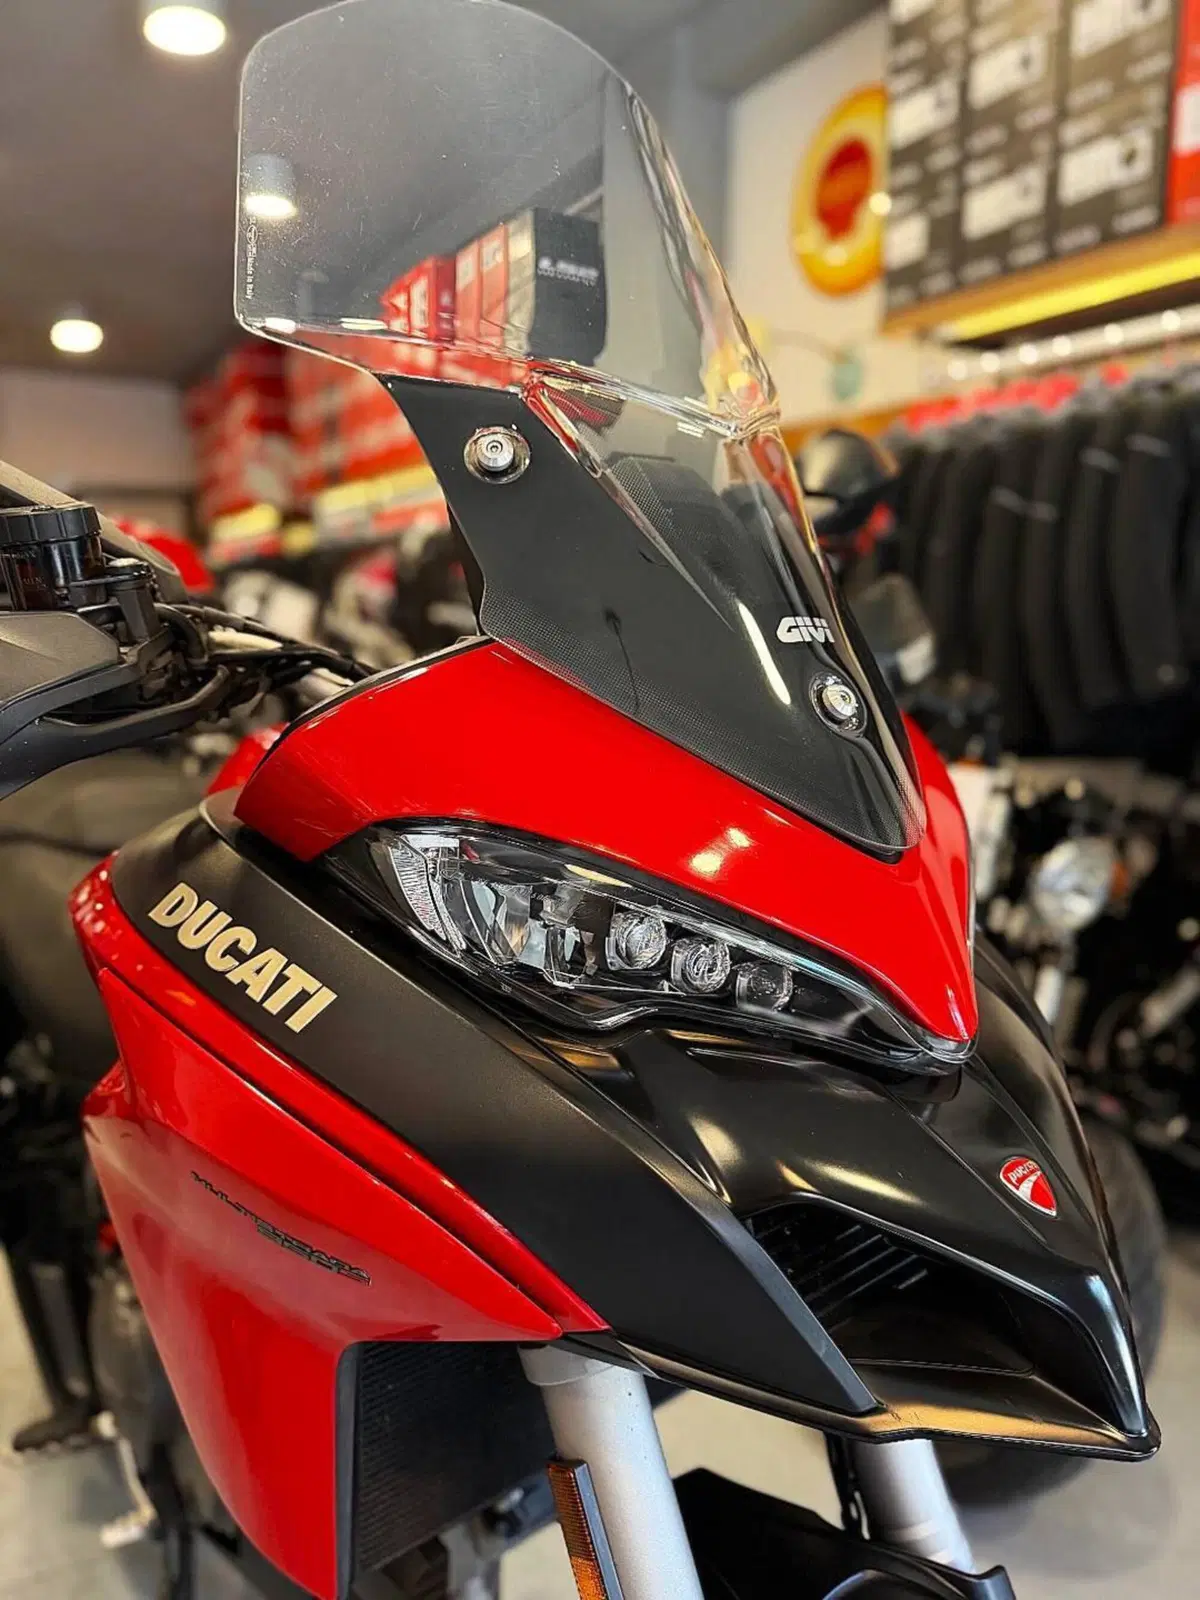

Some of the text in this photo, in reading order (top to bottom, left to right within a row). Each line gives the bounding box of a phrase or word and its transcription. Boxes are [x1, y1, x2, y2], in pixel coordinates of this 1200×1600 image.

[246, 258, 255, 274] Made
[245, 284, 254, 299] Italy
[776, 616, 835, 643] GIVI
[148, 882, 338, 1034] DUCATI
